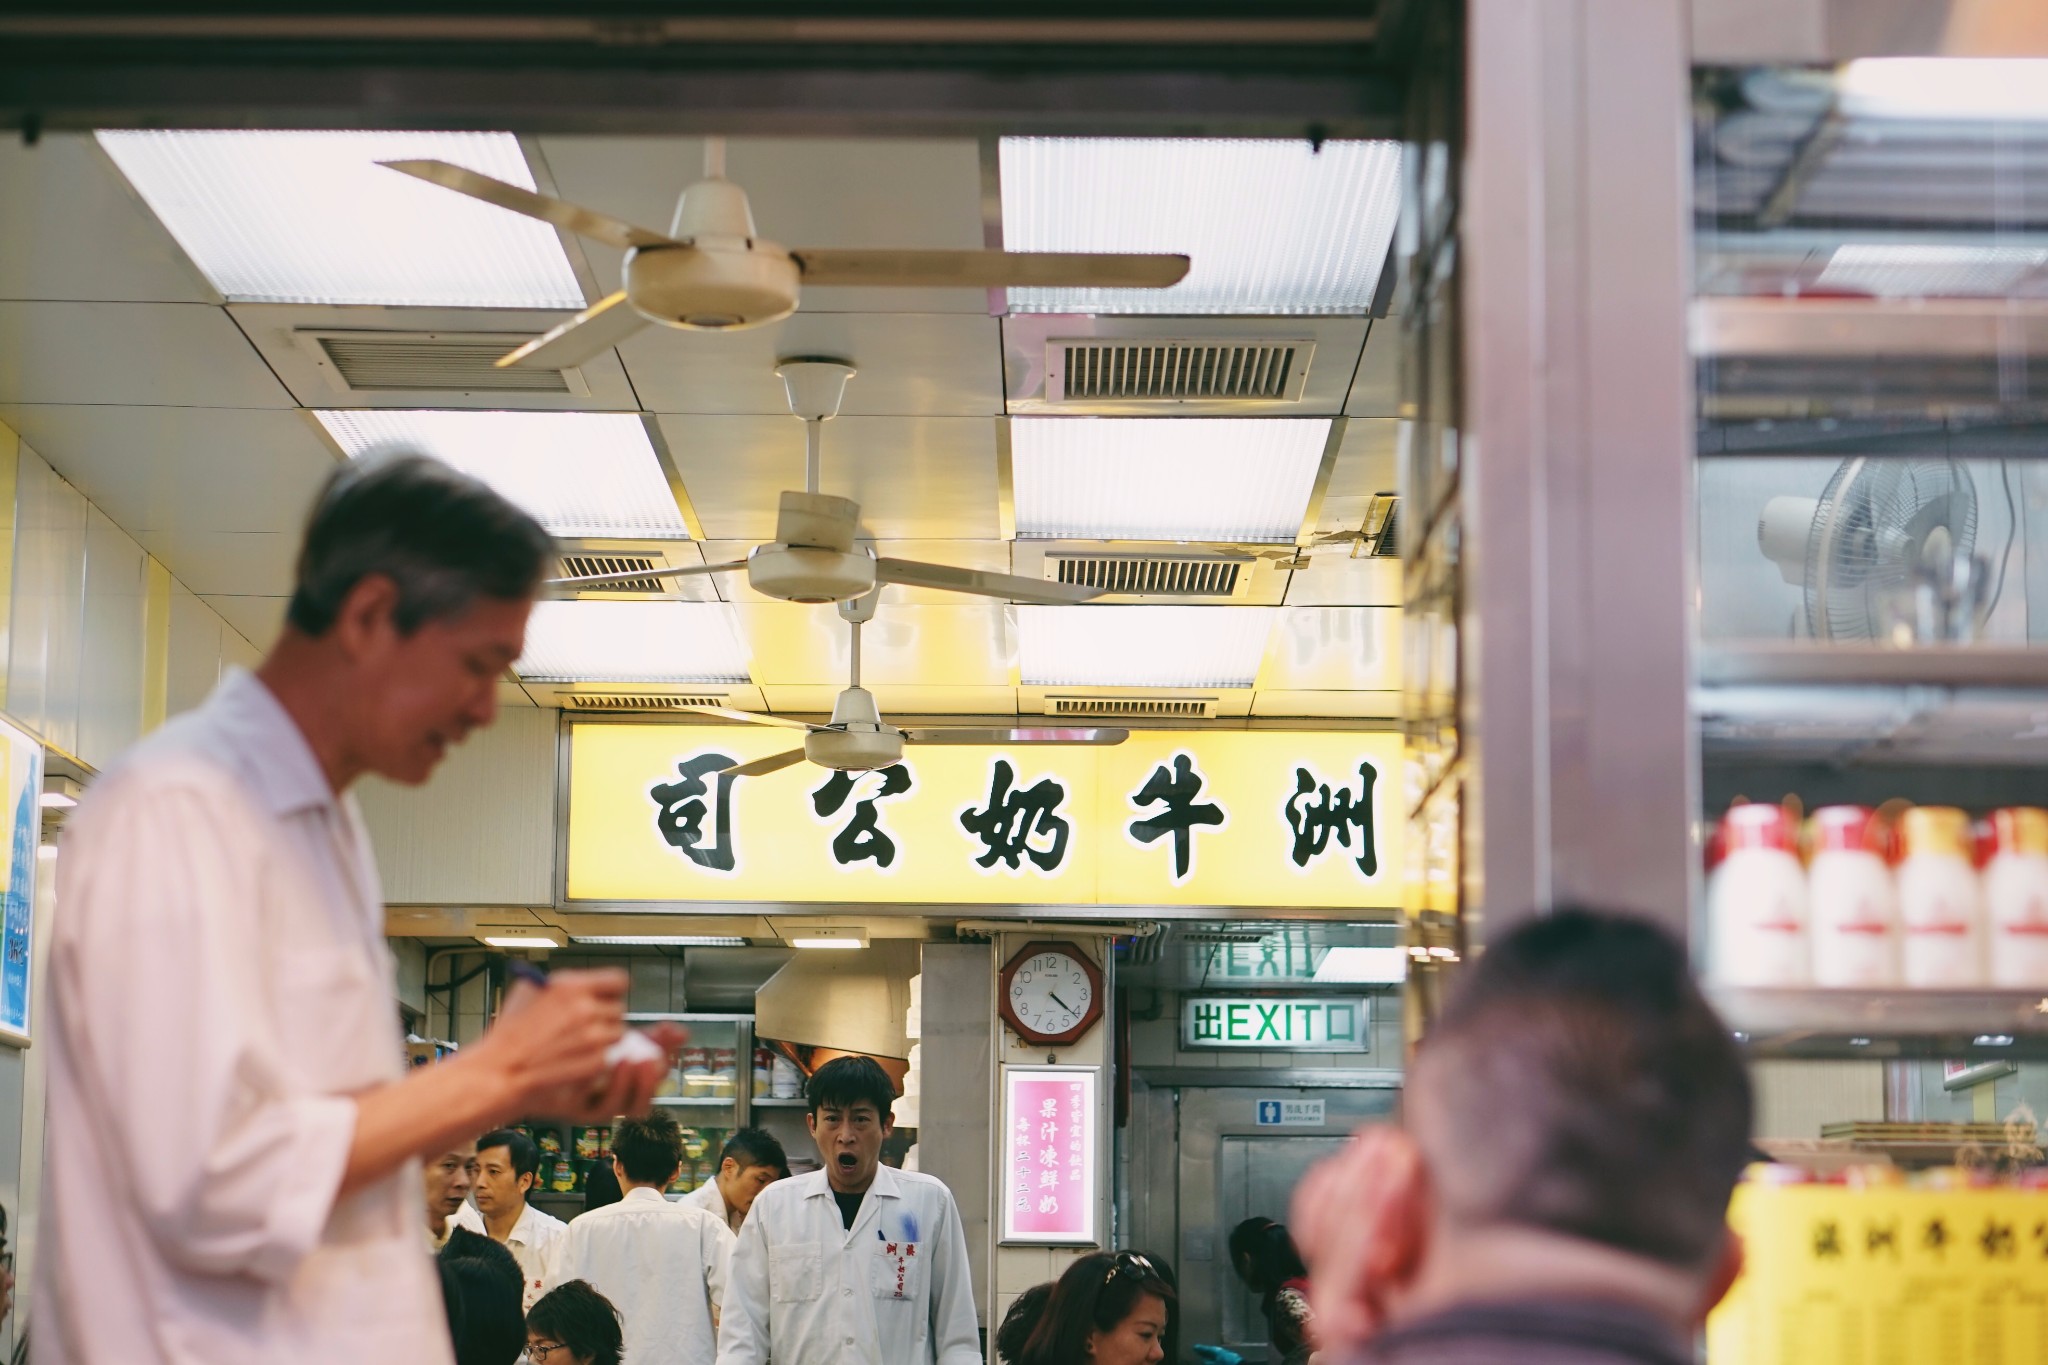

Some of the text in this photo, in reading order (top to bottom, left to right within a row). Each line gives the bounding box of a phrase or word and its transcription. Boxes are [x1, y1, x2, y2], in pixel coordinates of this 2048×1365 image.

[1033, 960, 1042, 972] 11
[1045, 956, 1057, 969] 12
[1020, 971, 1032, 984] 10
[1072, 972, 1081, 985] 2
[1014, 986, 1023, 1000] 9
[1080, 988, 1088, 1001] 3
[1020, 1002, 1029, 1016] 8
[1033, 1014, 1042, 1027] 7
[1046, 1018, 1055, 1032] 6
[1061, 1014, 1070, 1028] 5
[1038, 1098, 1060, 1215] 果汁凍鮮奶
